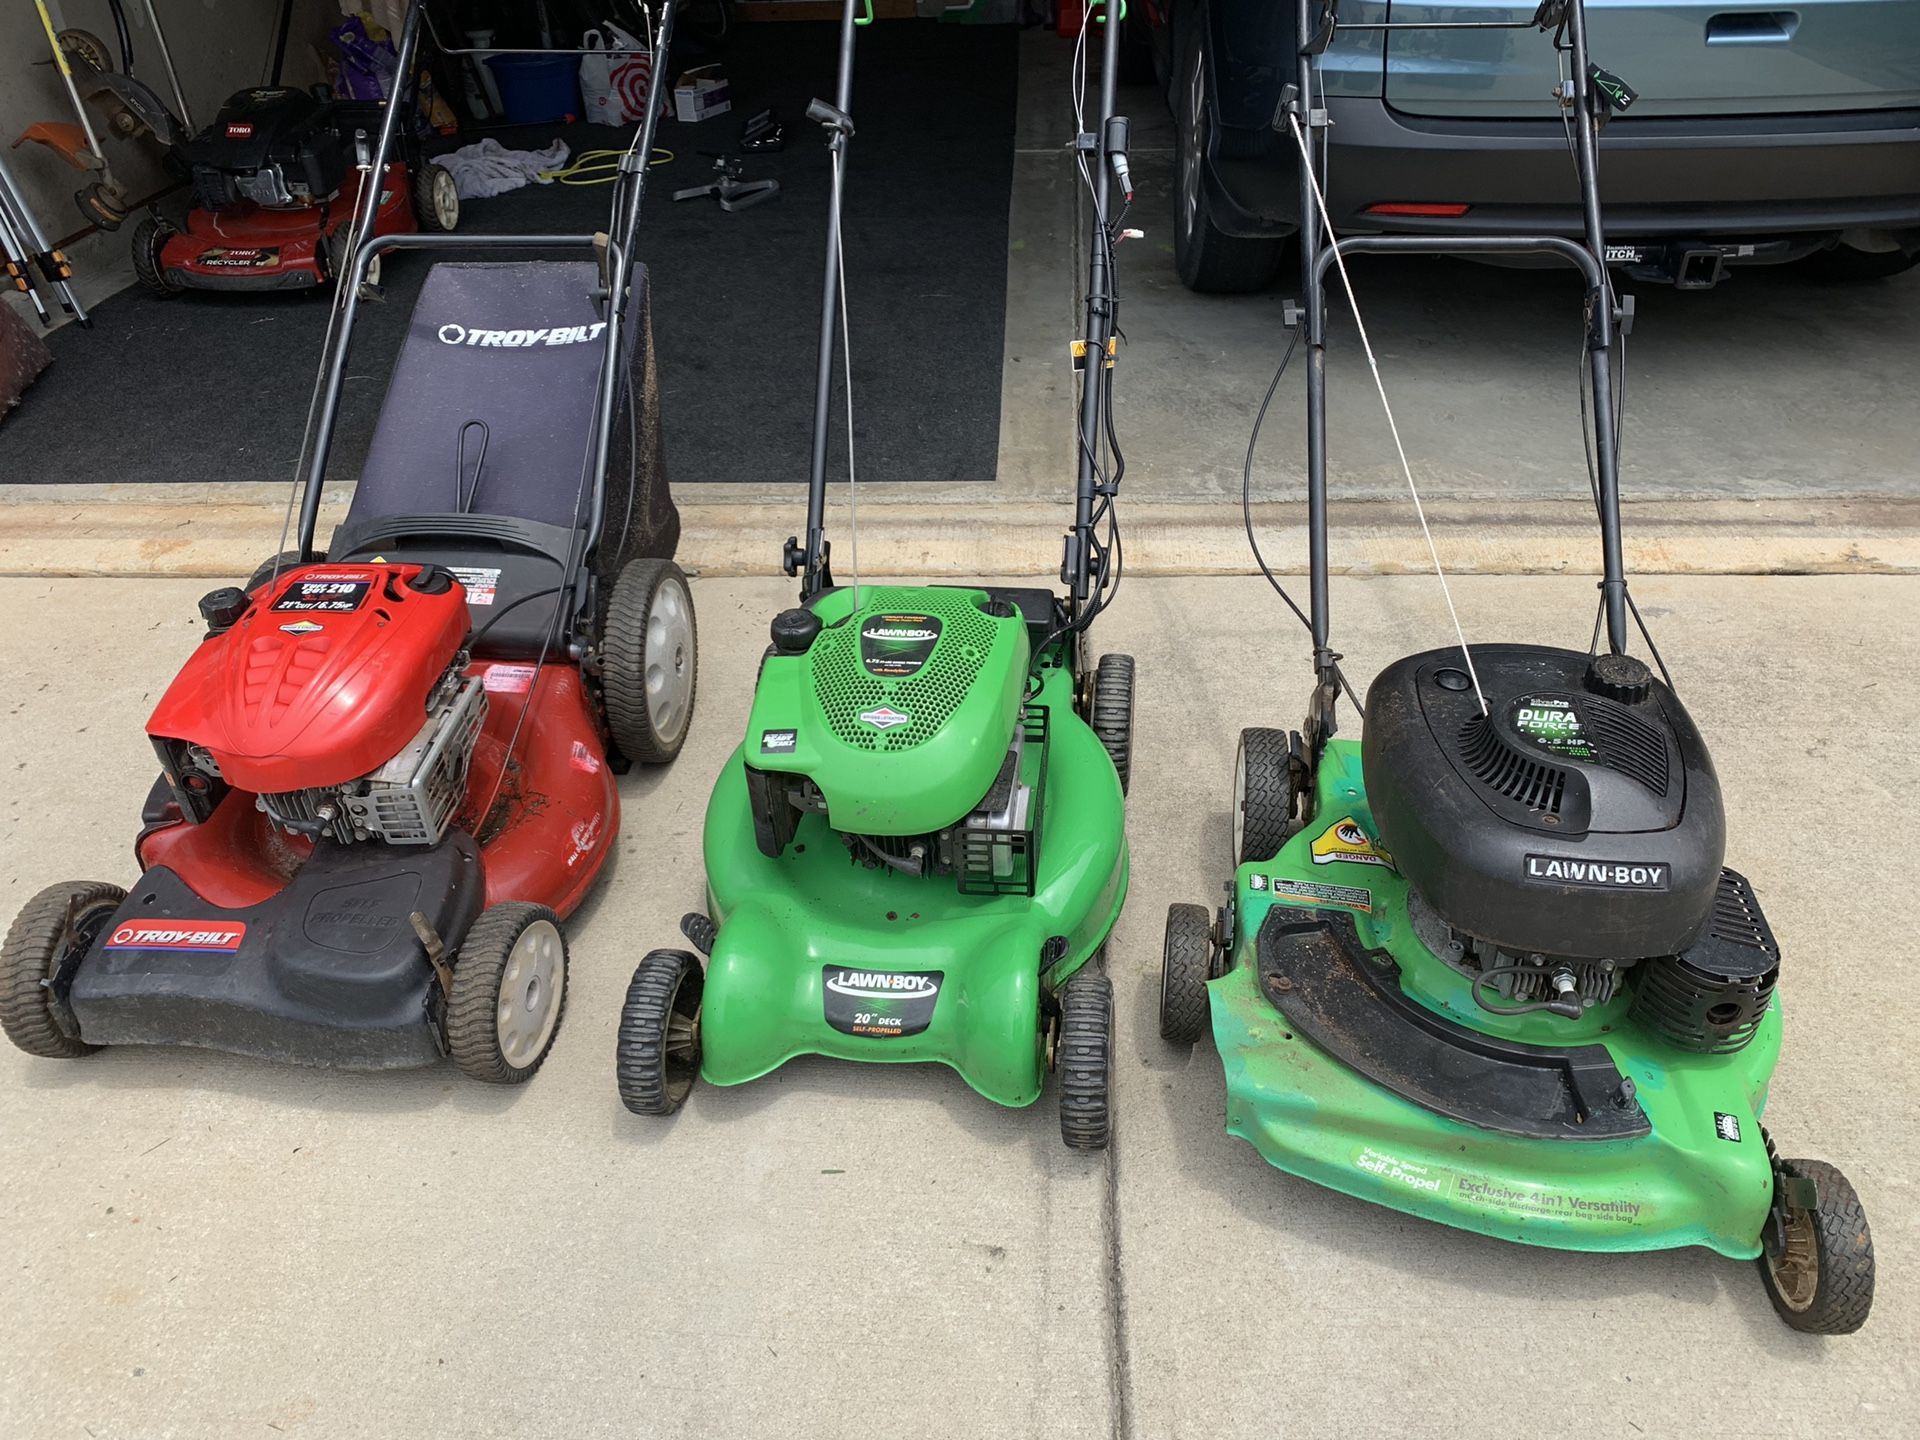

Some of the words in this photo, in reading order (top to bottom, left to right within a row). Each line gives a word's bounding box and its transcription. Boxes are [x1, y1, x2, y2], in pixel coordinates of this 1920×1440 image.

[228, 126, 251, 134] TORO
[1605, 249, 1634, 259] ITCH
[466, 322, 607, 347] TROY-BILT
[326, 583, 357, 594] 210
[1518, 709, 1577, 723] DURA
[1517, 721, 1580, 731] FORCE
[1537, 737, 1562, 745] 6.5
[1567, 738, 1586, 746] HP
[1335, 853, 1377, 862] DANGER
[133, 930, 238, 944] TROY-BILT
[878, 1017, 902, 1026] DECK
[852, 1026, 902, 1035] SELF-PROPELLED
[1356, 1155, 1441, 1191] Self-Propel
[1459, 1178, 1526, 1201] Exclusive
[1616, 1213, 1633, 1224] bag
